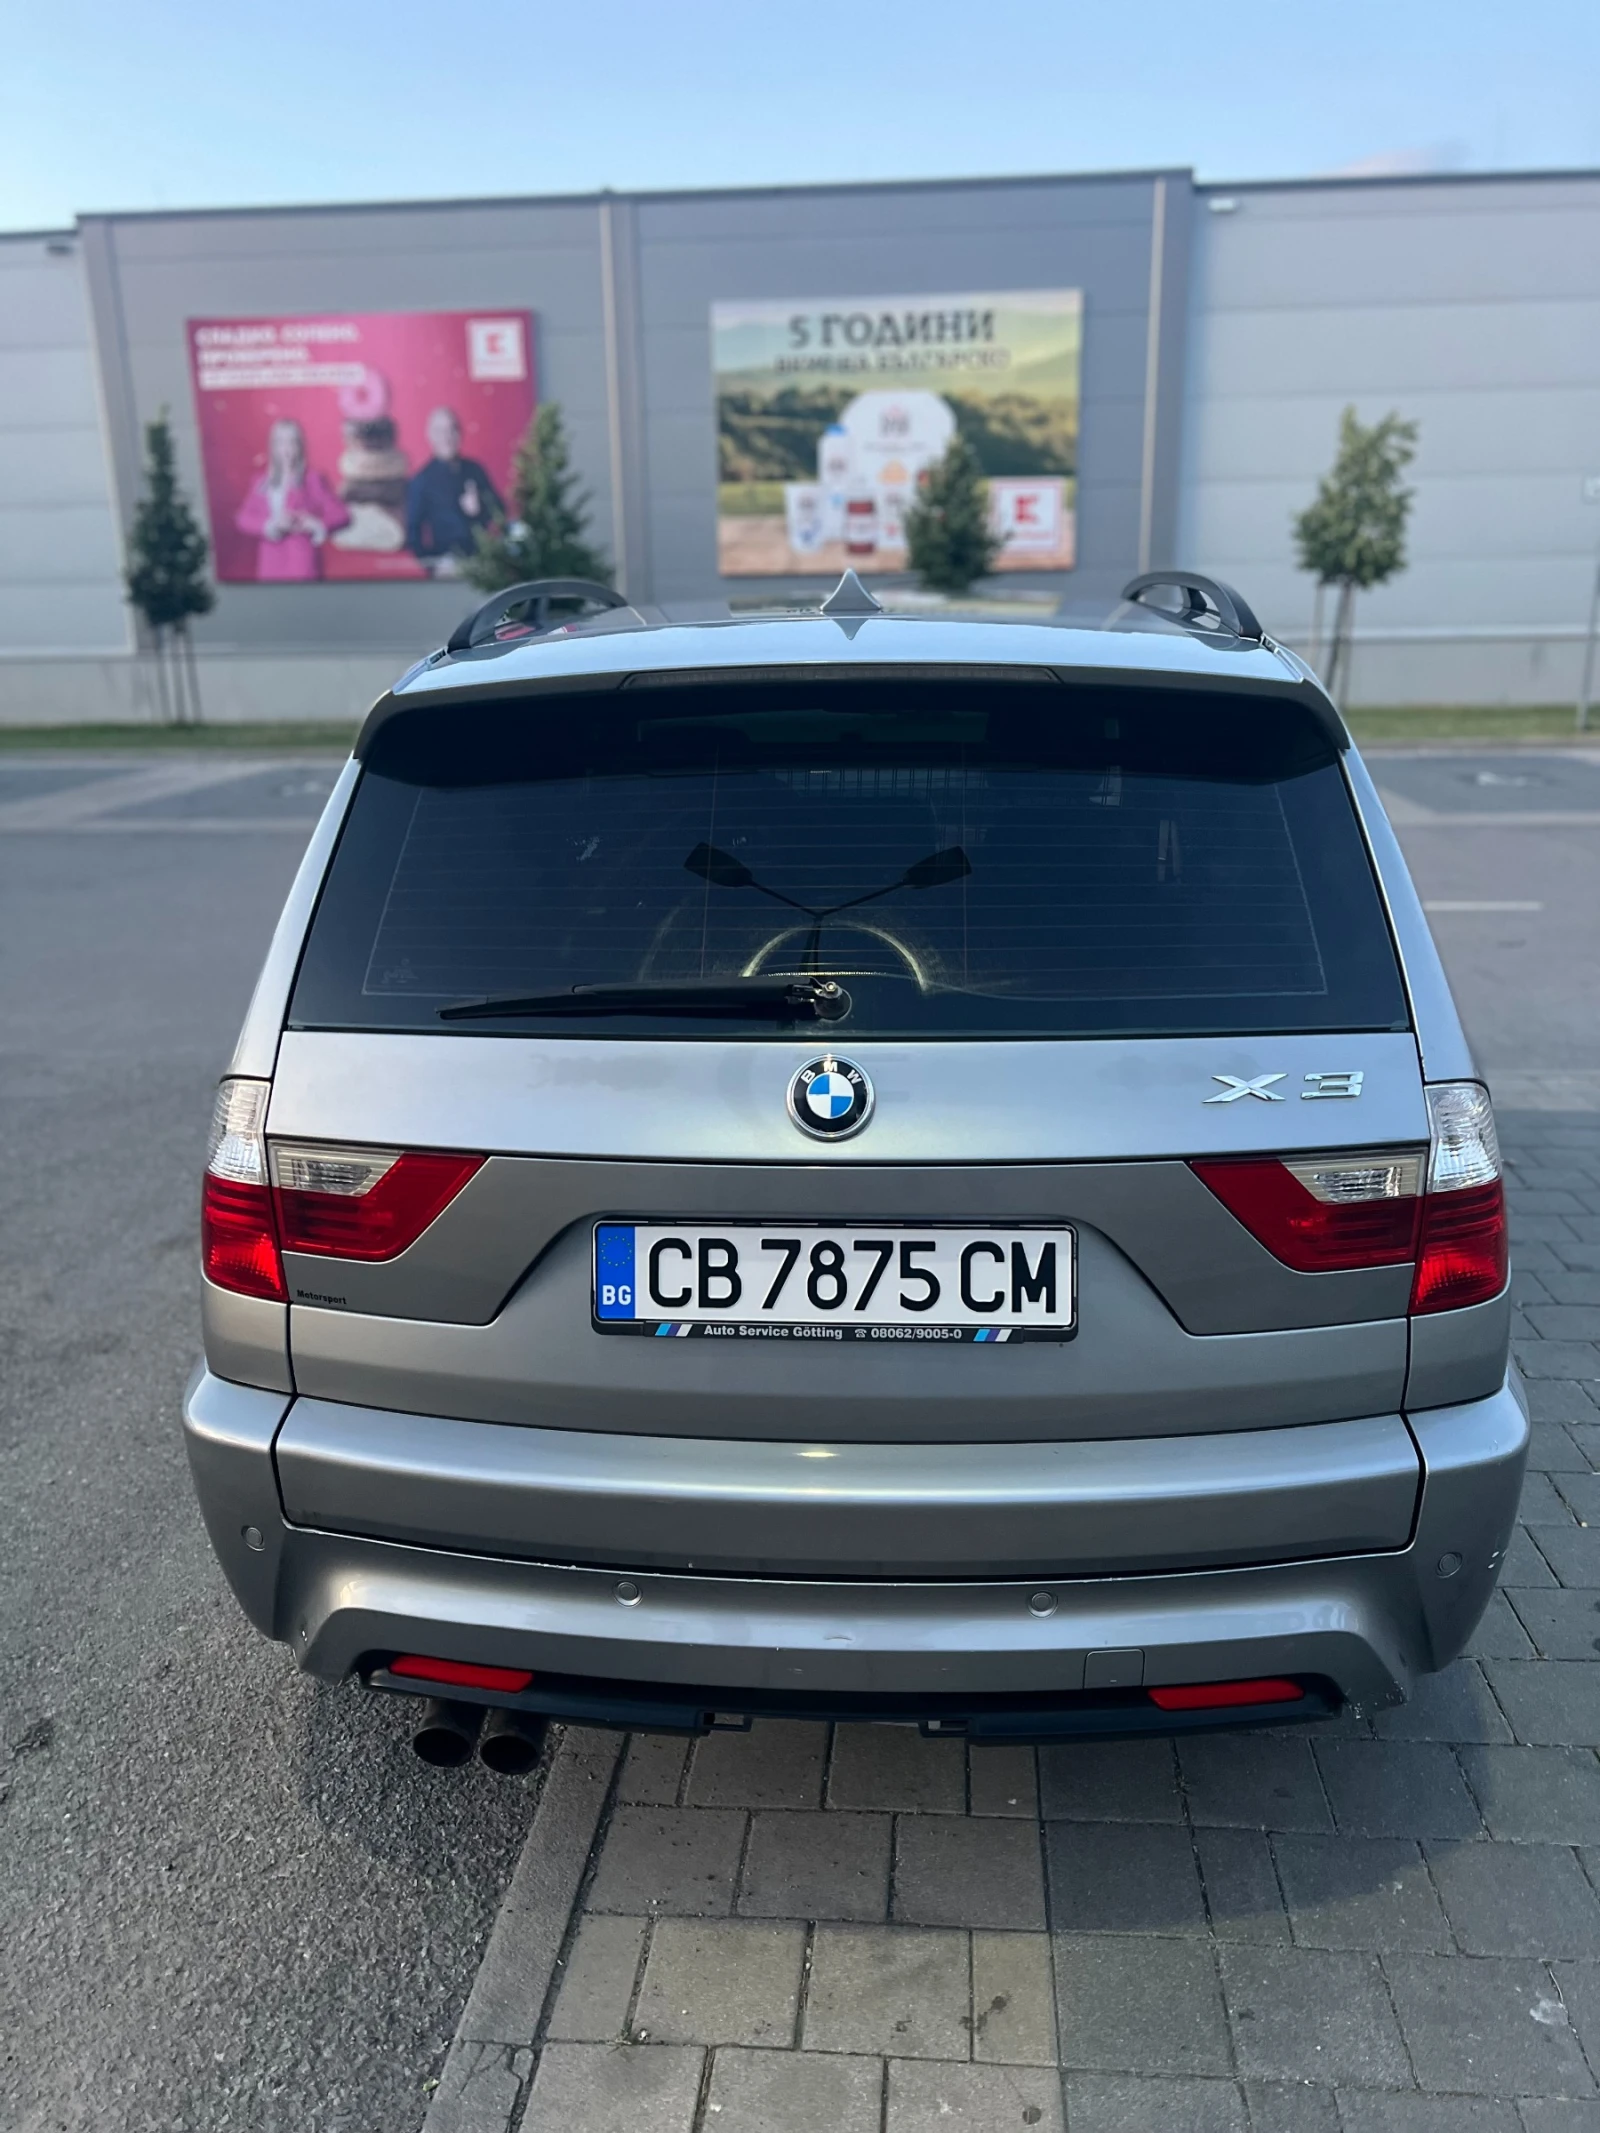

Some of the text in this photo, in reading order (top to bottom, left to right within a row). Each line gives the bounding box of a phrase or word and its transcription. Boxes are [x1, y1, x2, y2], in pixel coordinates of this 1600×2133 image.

[788, 309, 995, 350] 5 ГОДИНИ
[801, 1061, 862, 1085] BMW
[648, 1237, 1057, 1314] CB 7875 CM
[296, 1289, 347, 1305] Motorsport
[602, 1285, 632, 1306] BG
[703, 1325, 962, 1340] Auto Service Götting 08062/9005-0
